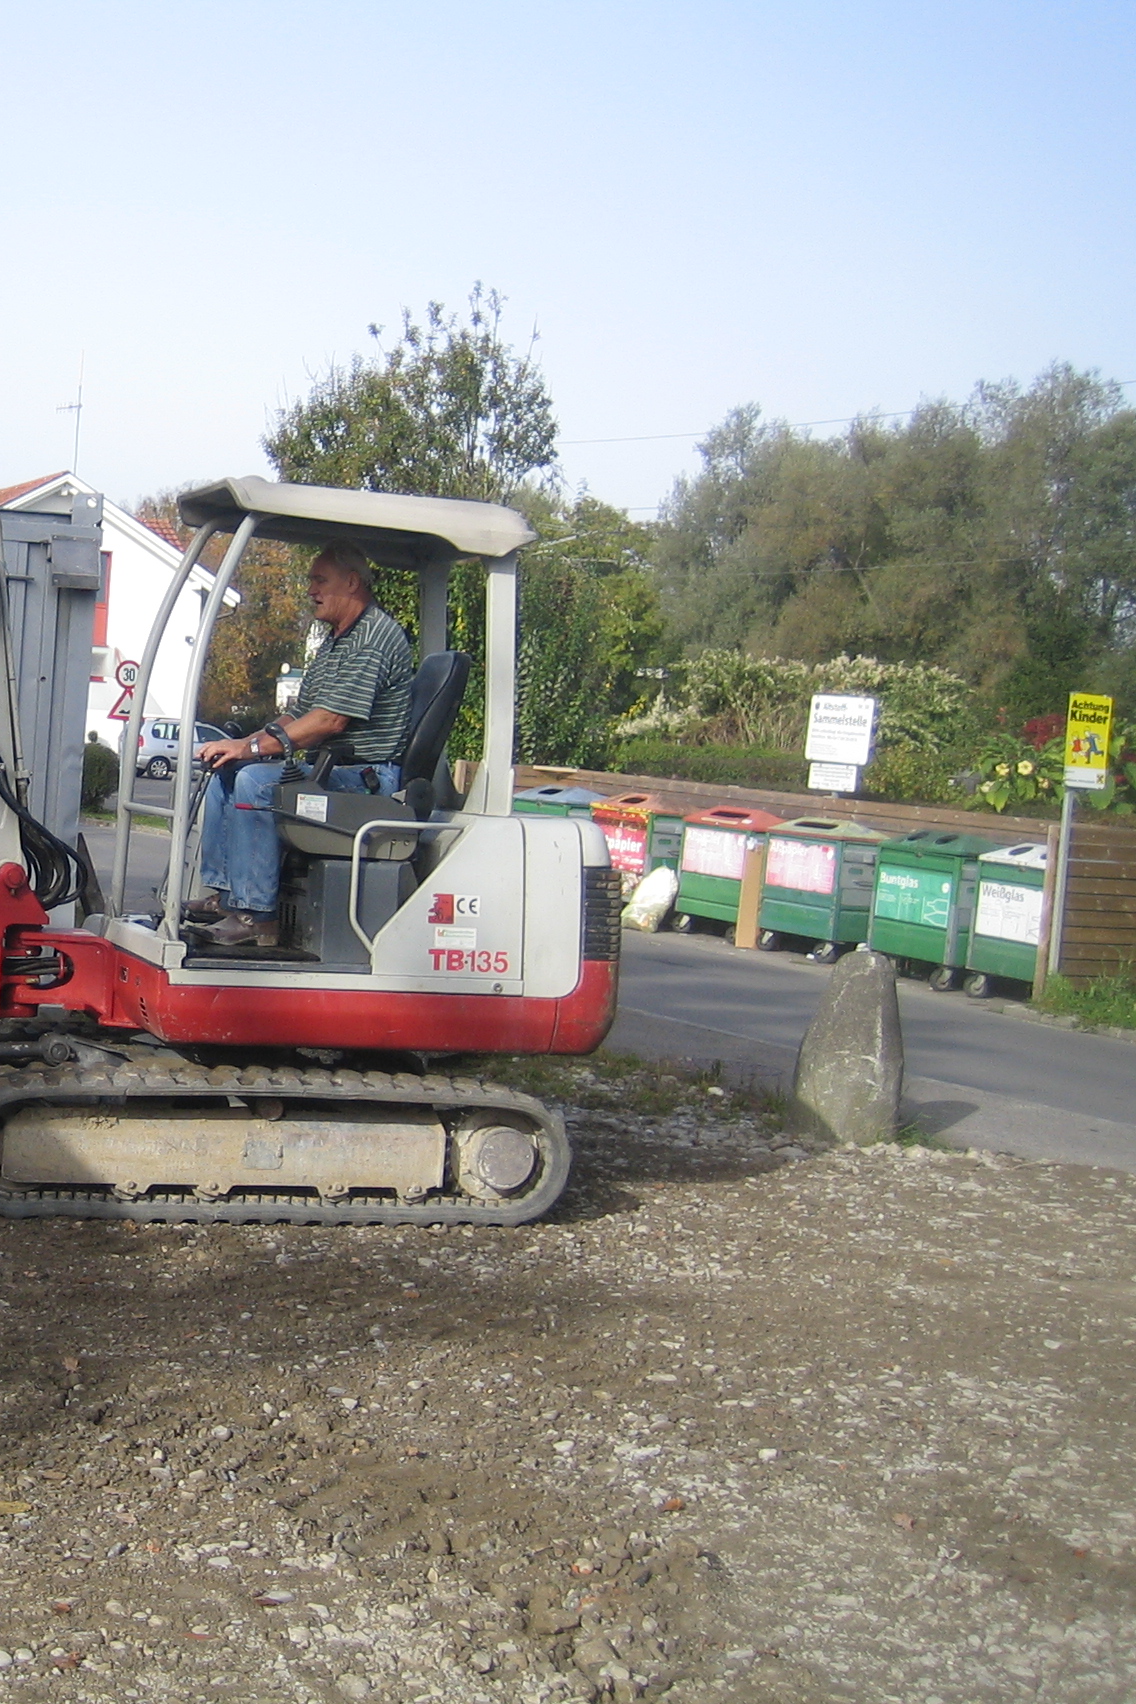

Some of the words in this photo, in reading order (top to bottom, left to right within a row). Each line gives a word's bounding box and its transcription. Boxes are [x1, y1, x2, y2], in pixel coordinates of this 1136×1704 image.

[123, 668, 136, 681] 30
[1071, 700, 1110, 713] Achtung
[1070, 709, 1109, 725] Kinder
[880, 871, 919, 889] Buntglas
[982, 884, 1025, 903] Weißglas
[456, 897, 479, 914] CE
